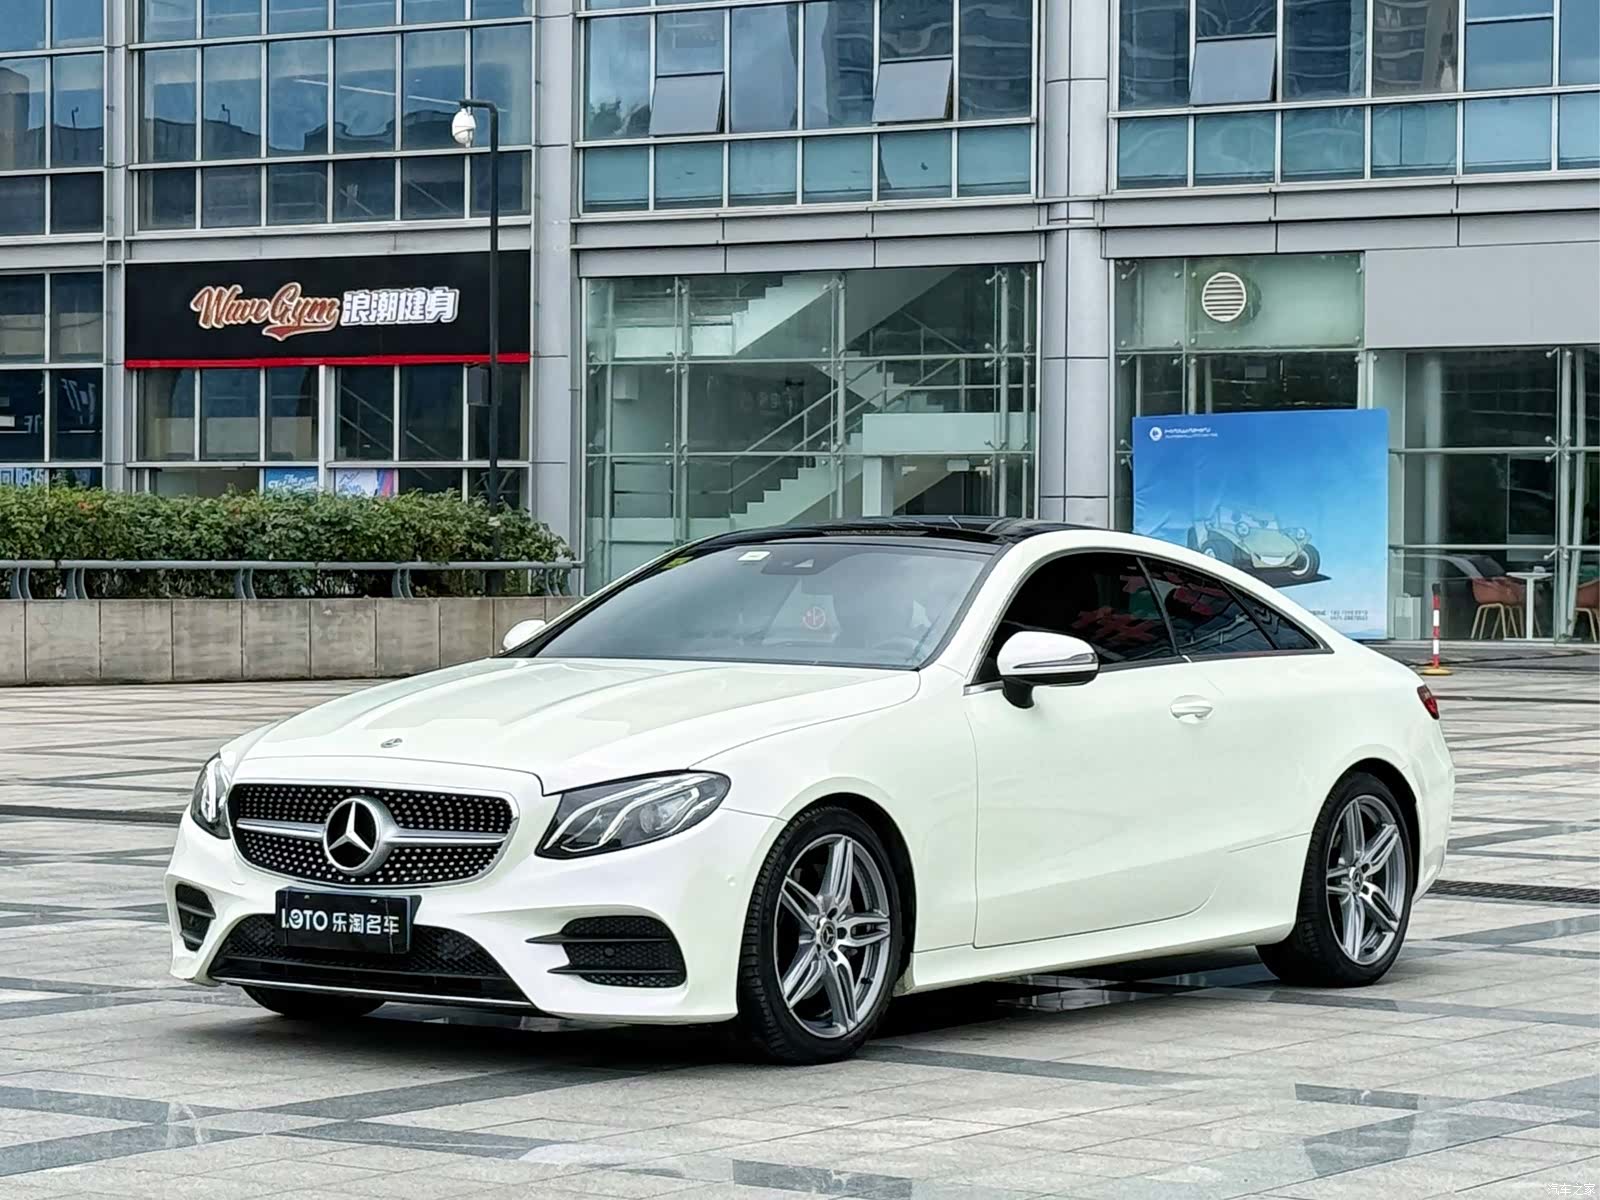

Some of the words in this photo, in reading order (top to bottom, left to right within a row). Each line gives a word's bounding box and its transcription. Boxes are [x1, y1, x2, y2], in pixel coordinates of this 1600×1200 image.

[190, 285, 270, 328] Wave
[263, 282, 340, 341] Gym
[341, 287, 459, 326] 浪潮健身
[281, 908, 328, 931] LOTO
[332, 912, 399, 935] 乐淘名车
